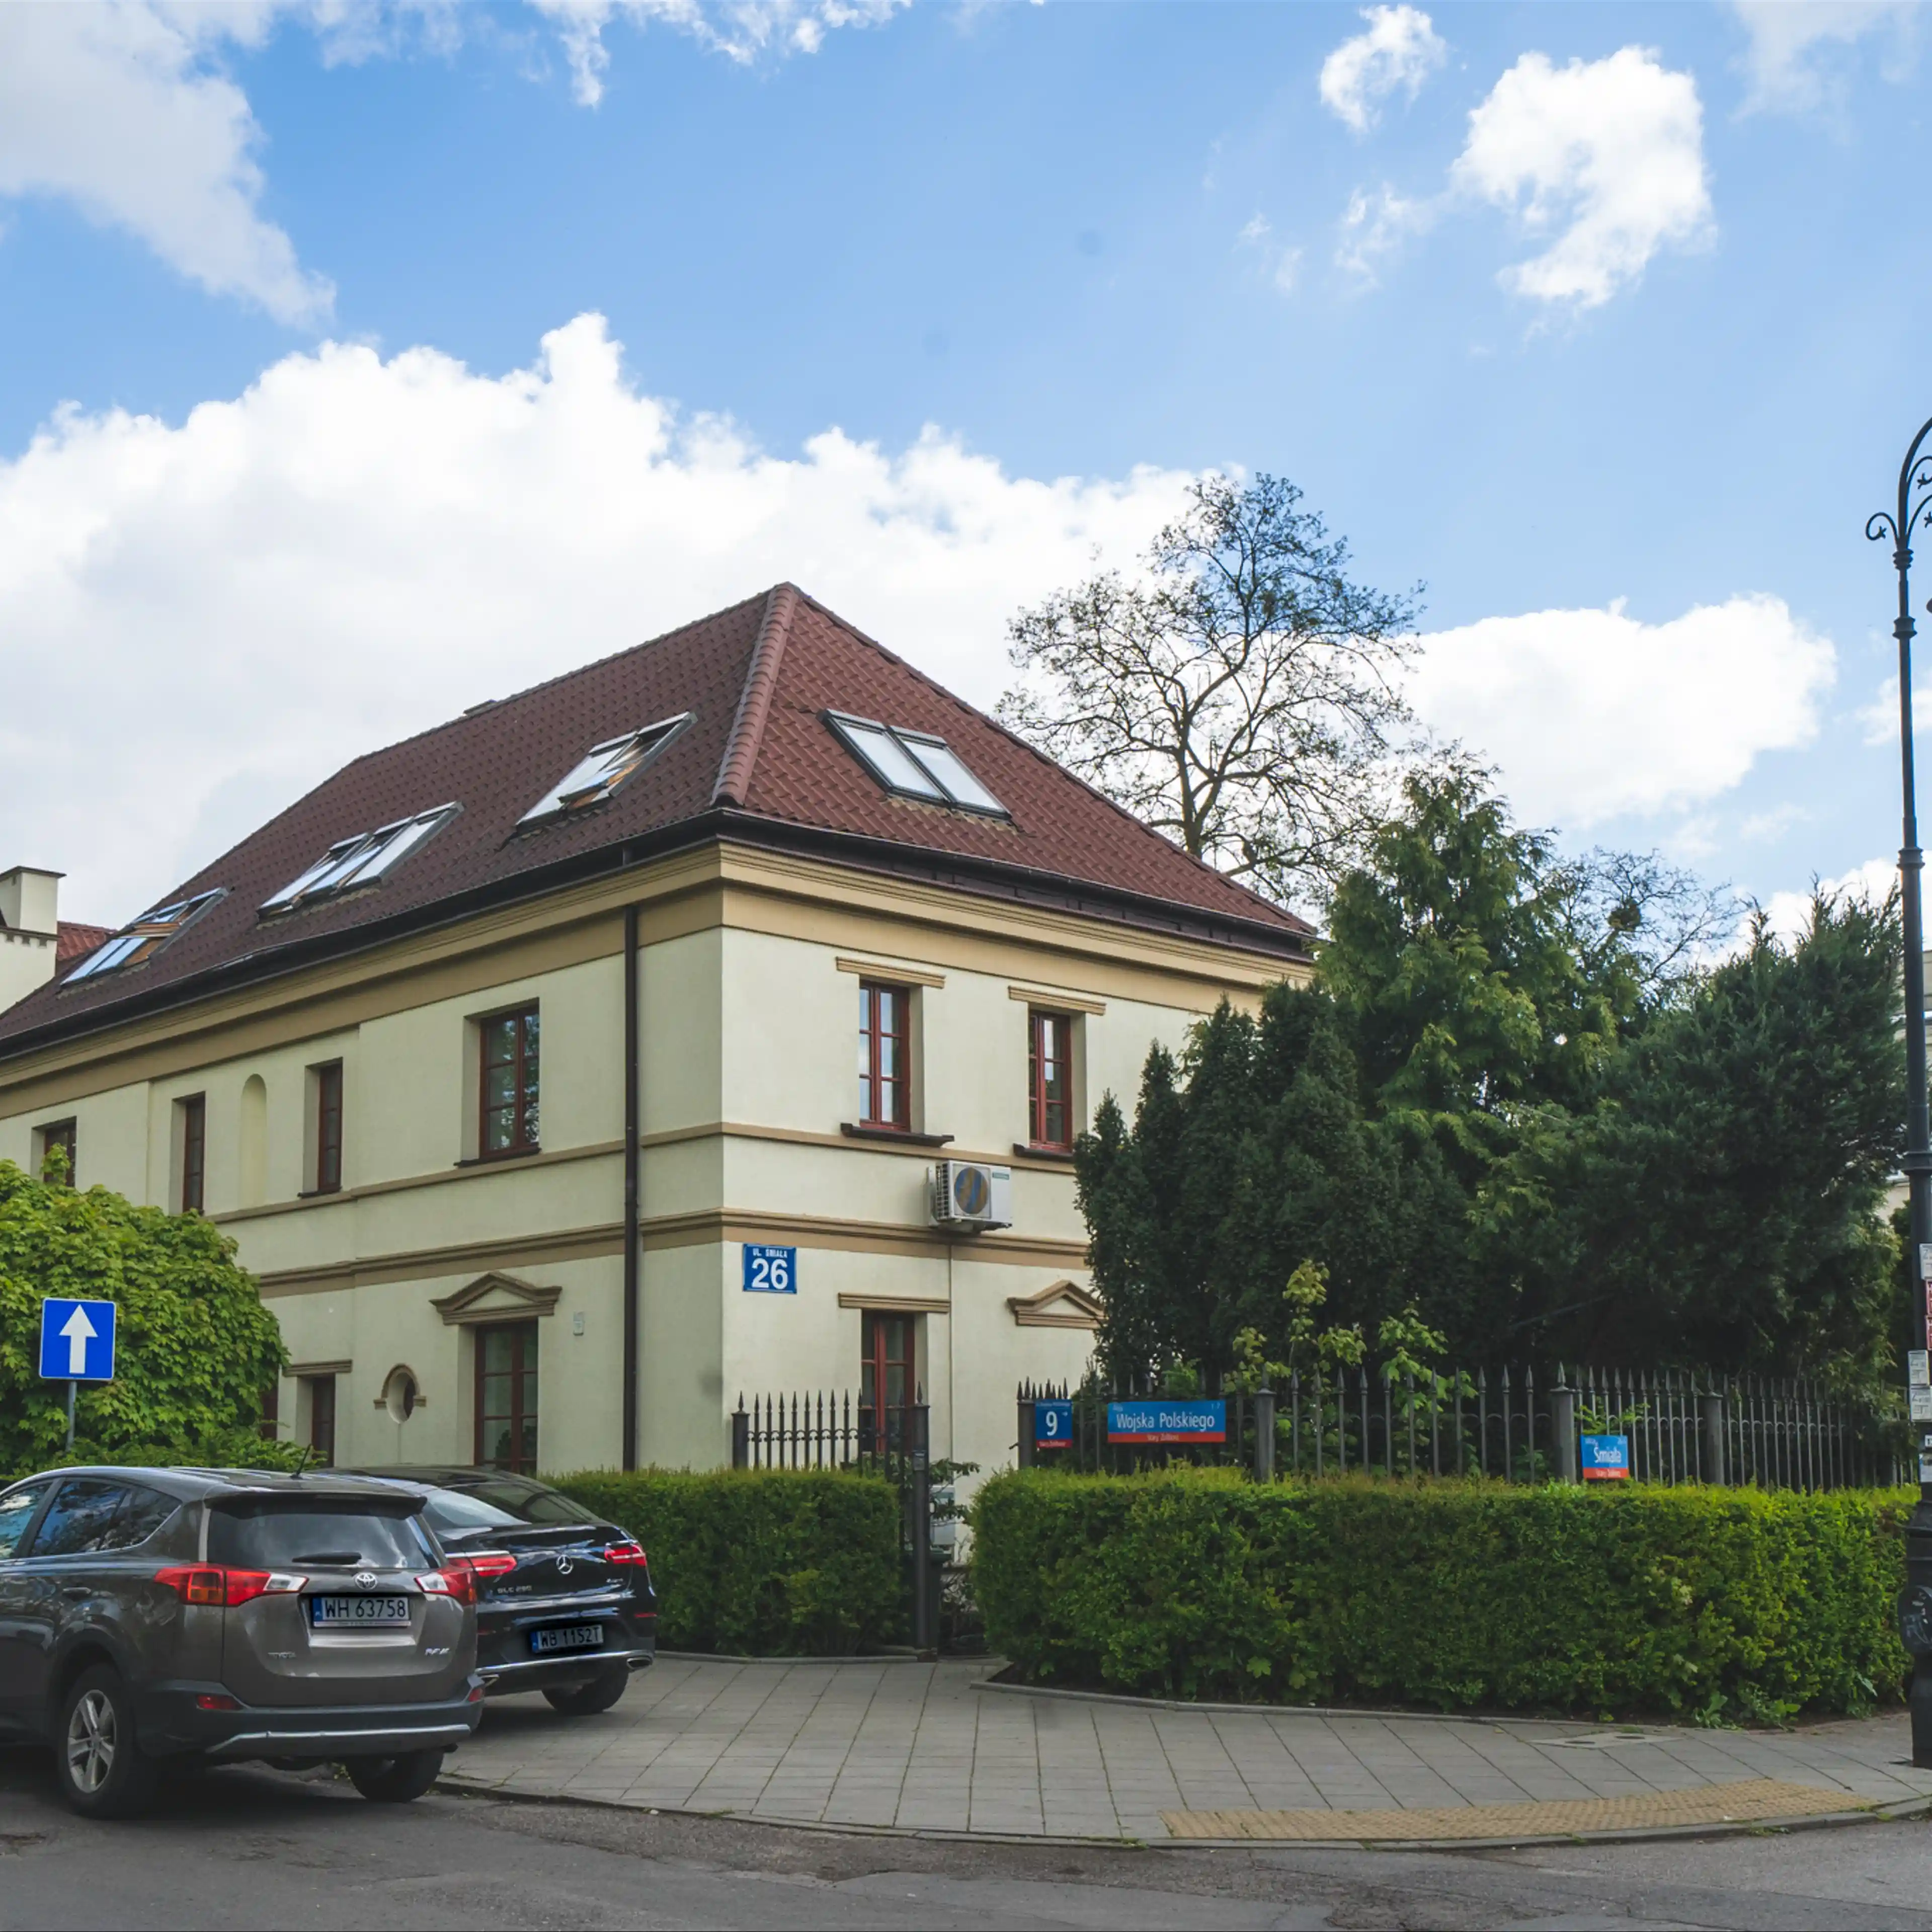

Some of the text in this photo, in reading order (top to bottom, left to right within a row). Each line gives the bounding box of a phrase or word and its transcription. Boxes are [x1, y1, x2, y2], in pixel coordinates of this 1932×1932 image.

[752, 1258, 788, 1290] 26
[1046, 1411, 1058, 1436] 9
[1116, 1411, 1215, 1433] Wojska Polskiego
[325, 1599, 406, 1618] WH 63758
[564, 1627, 600, 1644] 1152T
